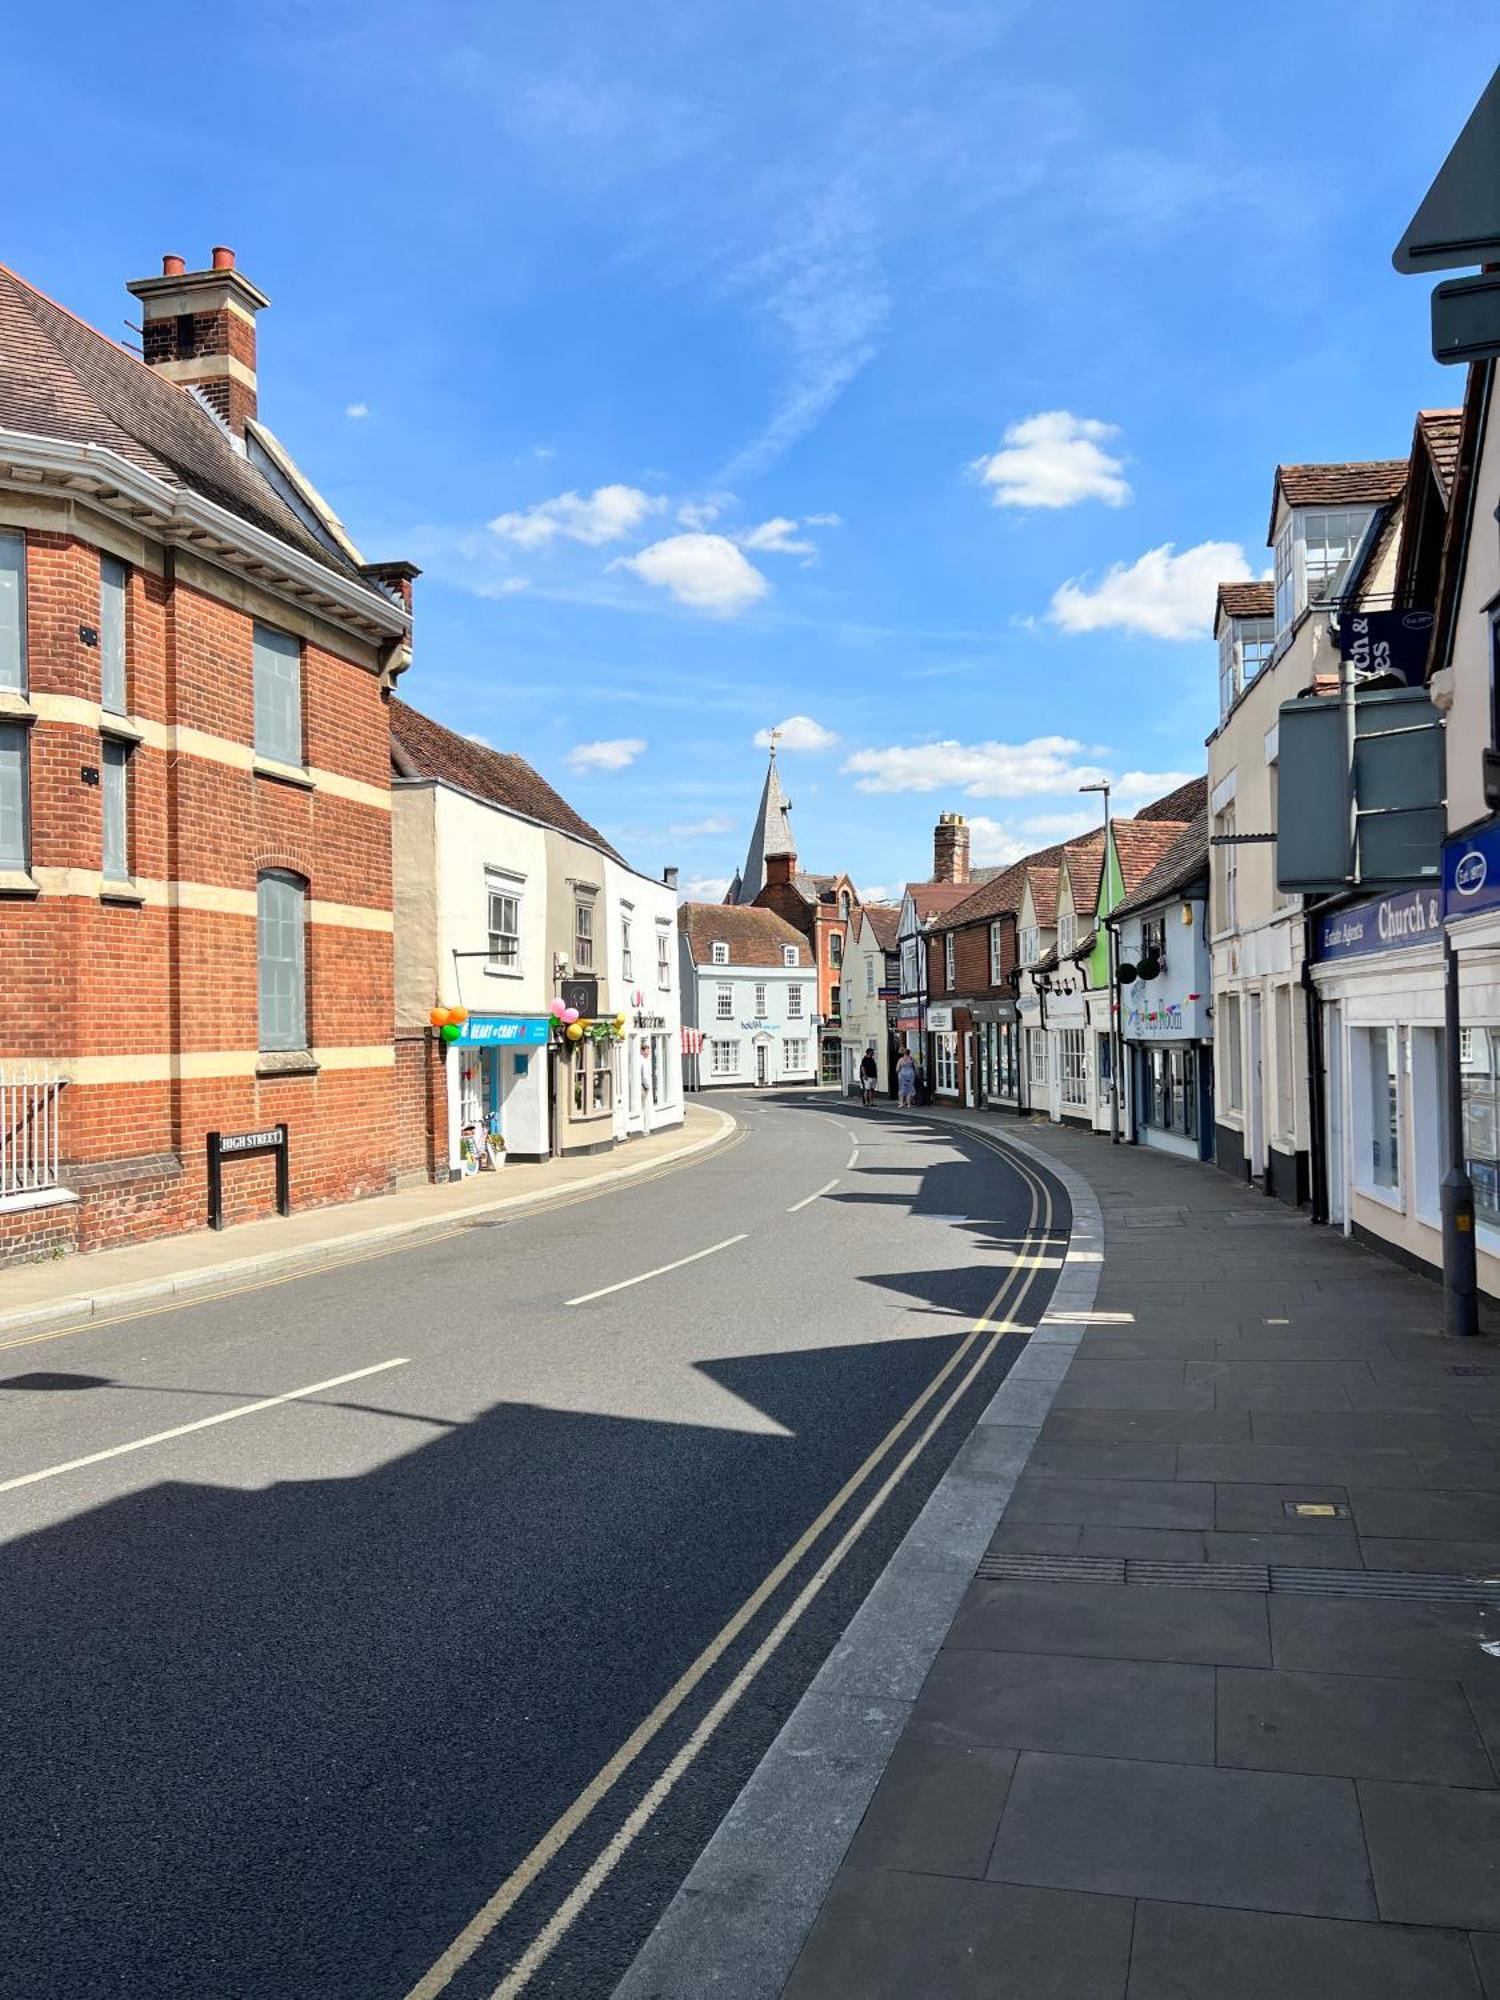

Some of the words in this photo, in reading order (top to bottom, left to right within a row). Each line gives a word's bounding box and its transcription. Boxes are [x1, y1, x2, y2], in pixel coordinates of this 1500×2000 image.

[1352, 617, 1369, 635] &
[1378, 893, 1425, 939] Church
[1428, 899, 1439, 928] &
[1343, 921, 1364, 947] Agents
[223, 1137, 246, 1150] HIGH
[247, 1131, 278, 1147] STREET
